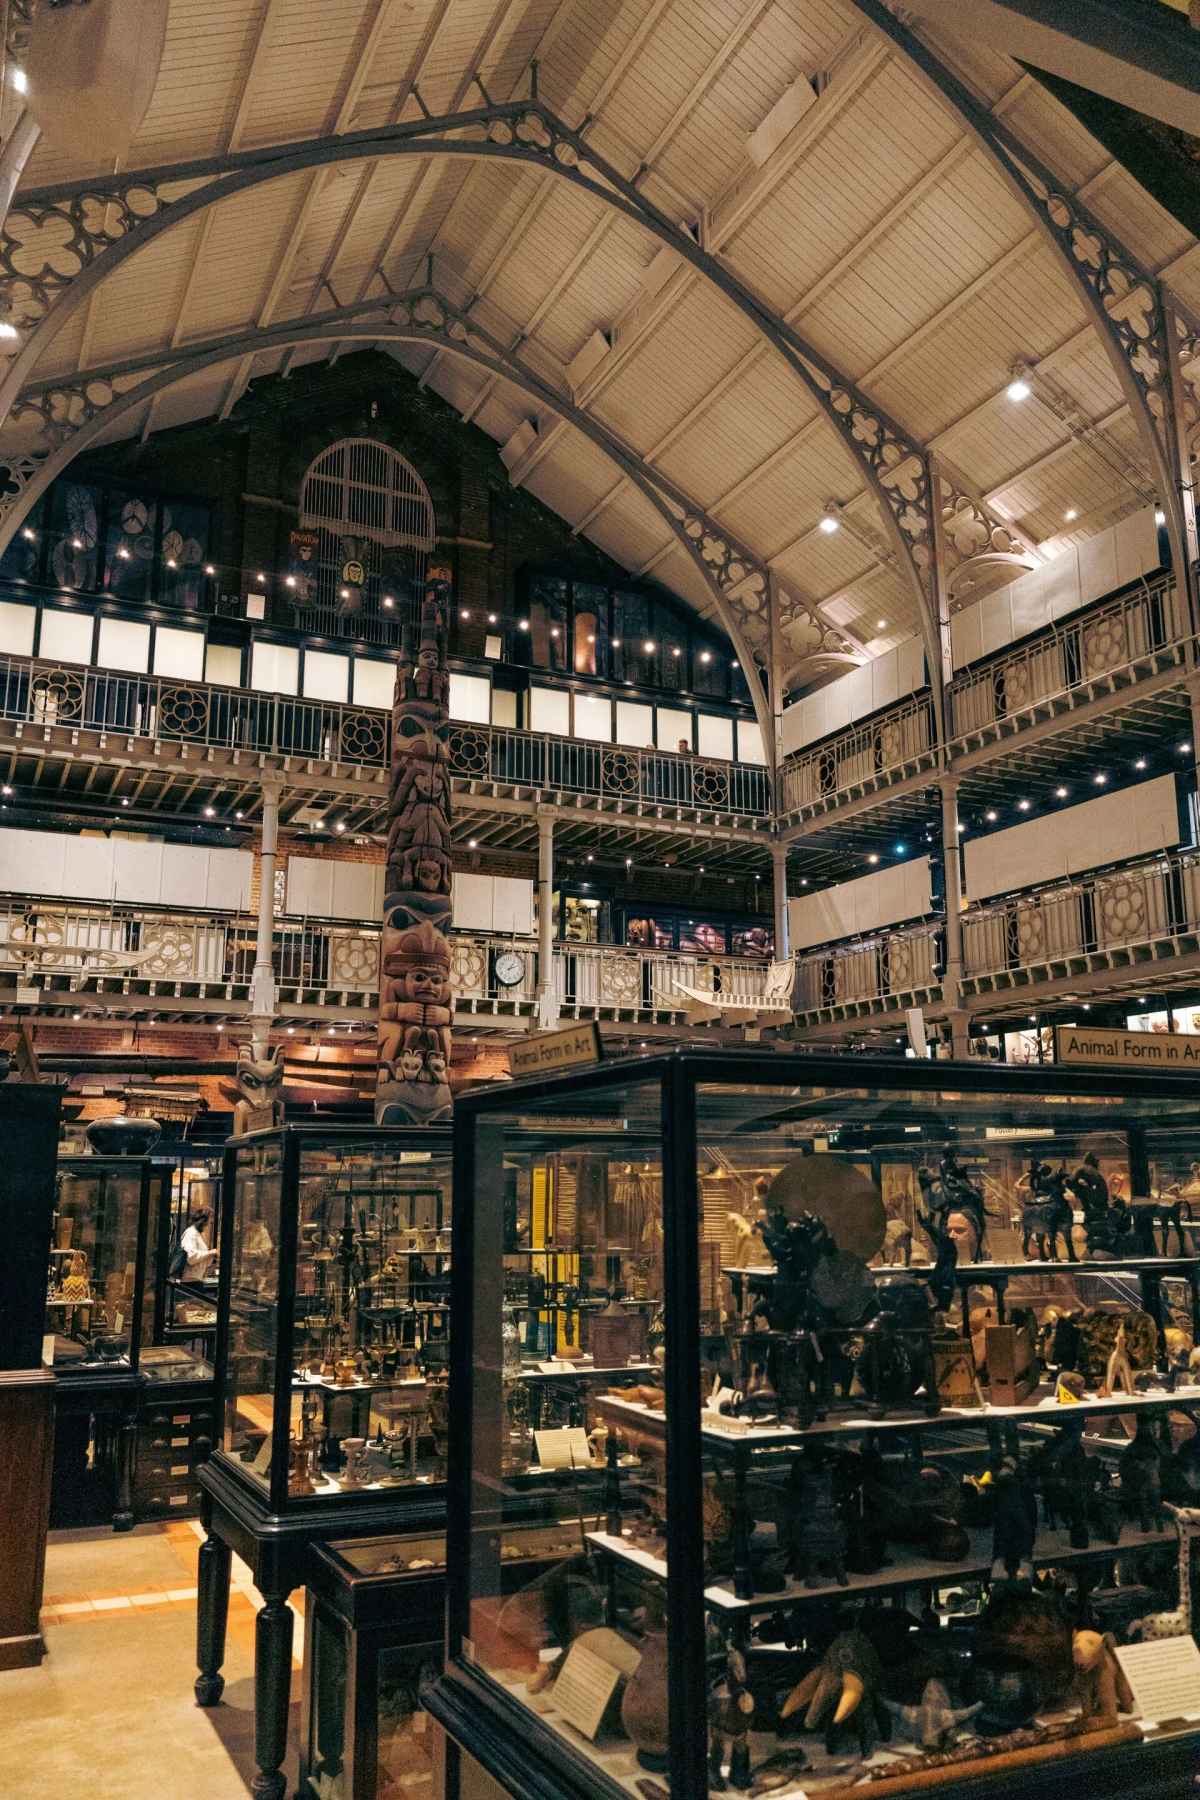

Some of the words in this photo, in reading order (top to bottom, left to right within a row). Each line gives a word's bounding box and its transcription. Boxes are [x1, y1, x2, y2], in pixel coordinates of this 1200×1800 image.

[540, 1044, 563, 1061] Form
[564, 1042, 572, 1057] in
[574, 1037, 591, 1053] Art
[1067, 1037, 1118, 1056] Animal
[1124, 1040, 1162, 1059] Form
[1166, 1044, 1178, 1059] in
